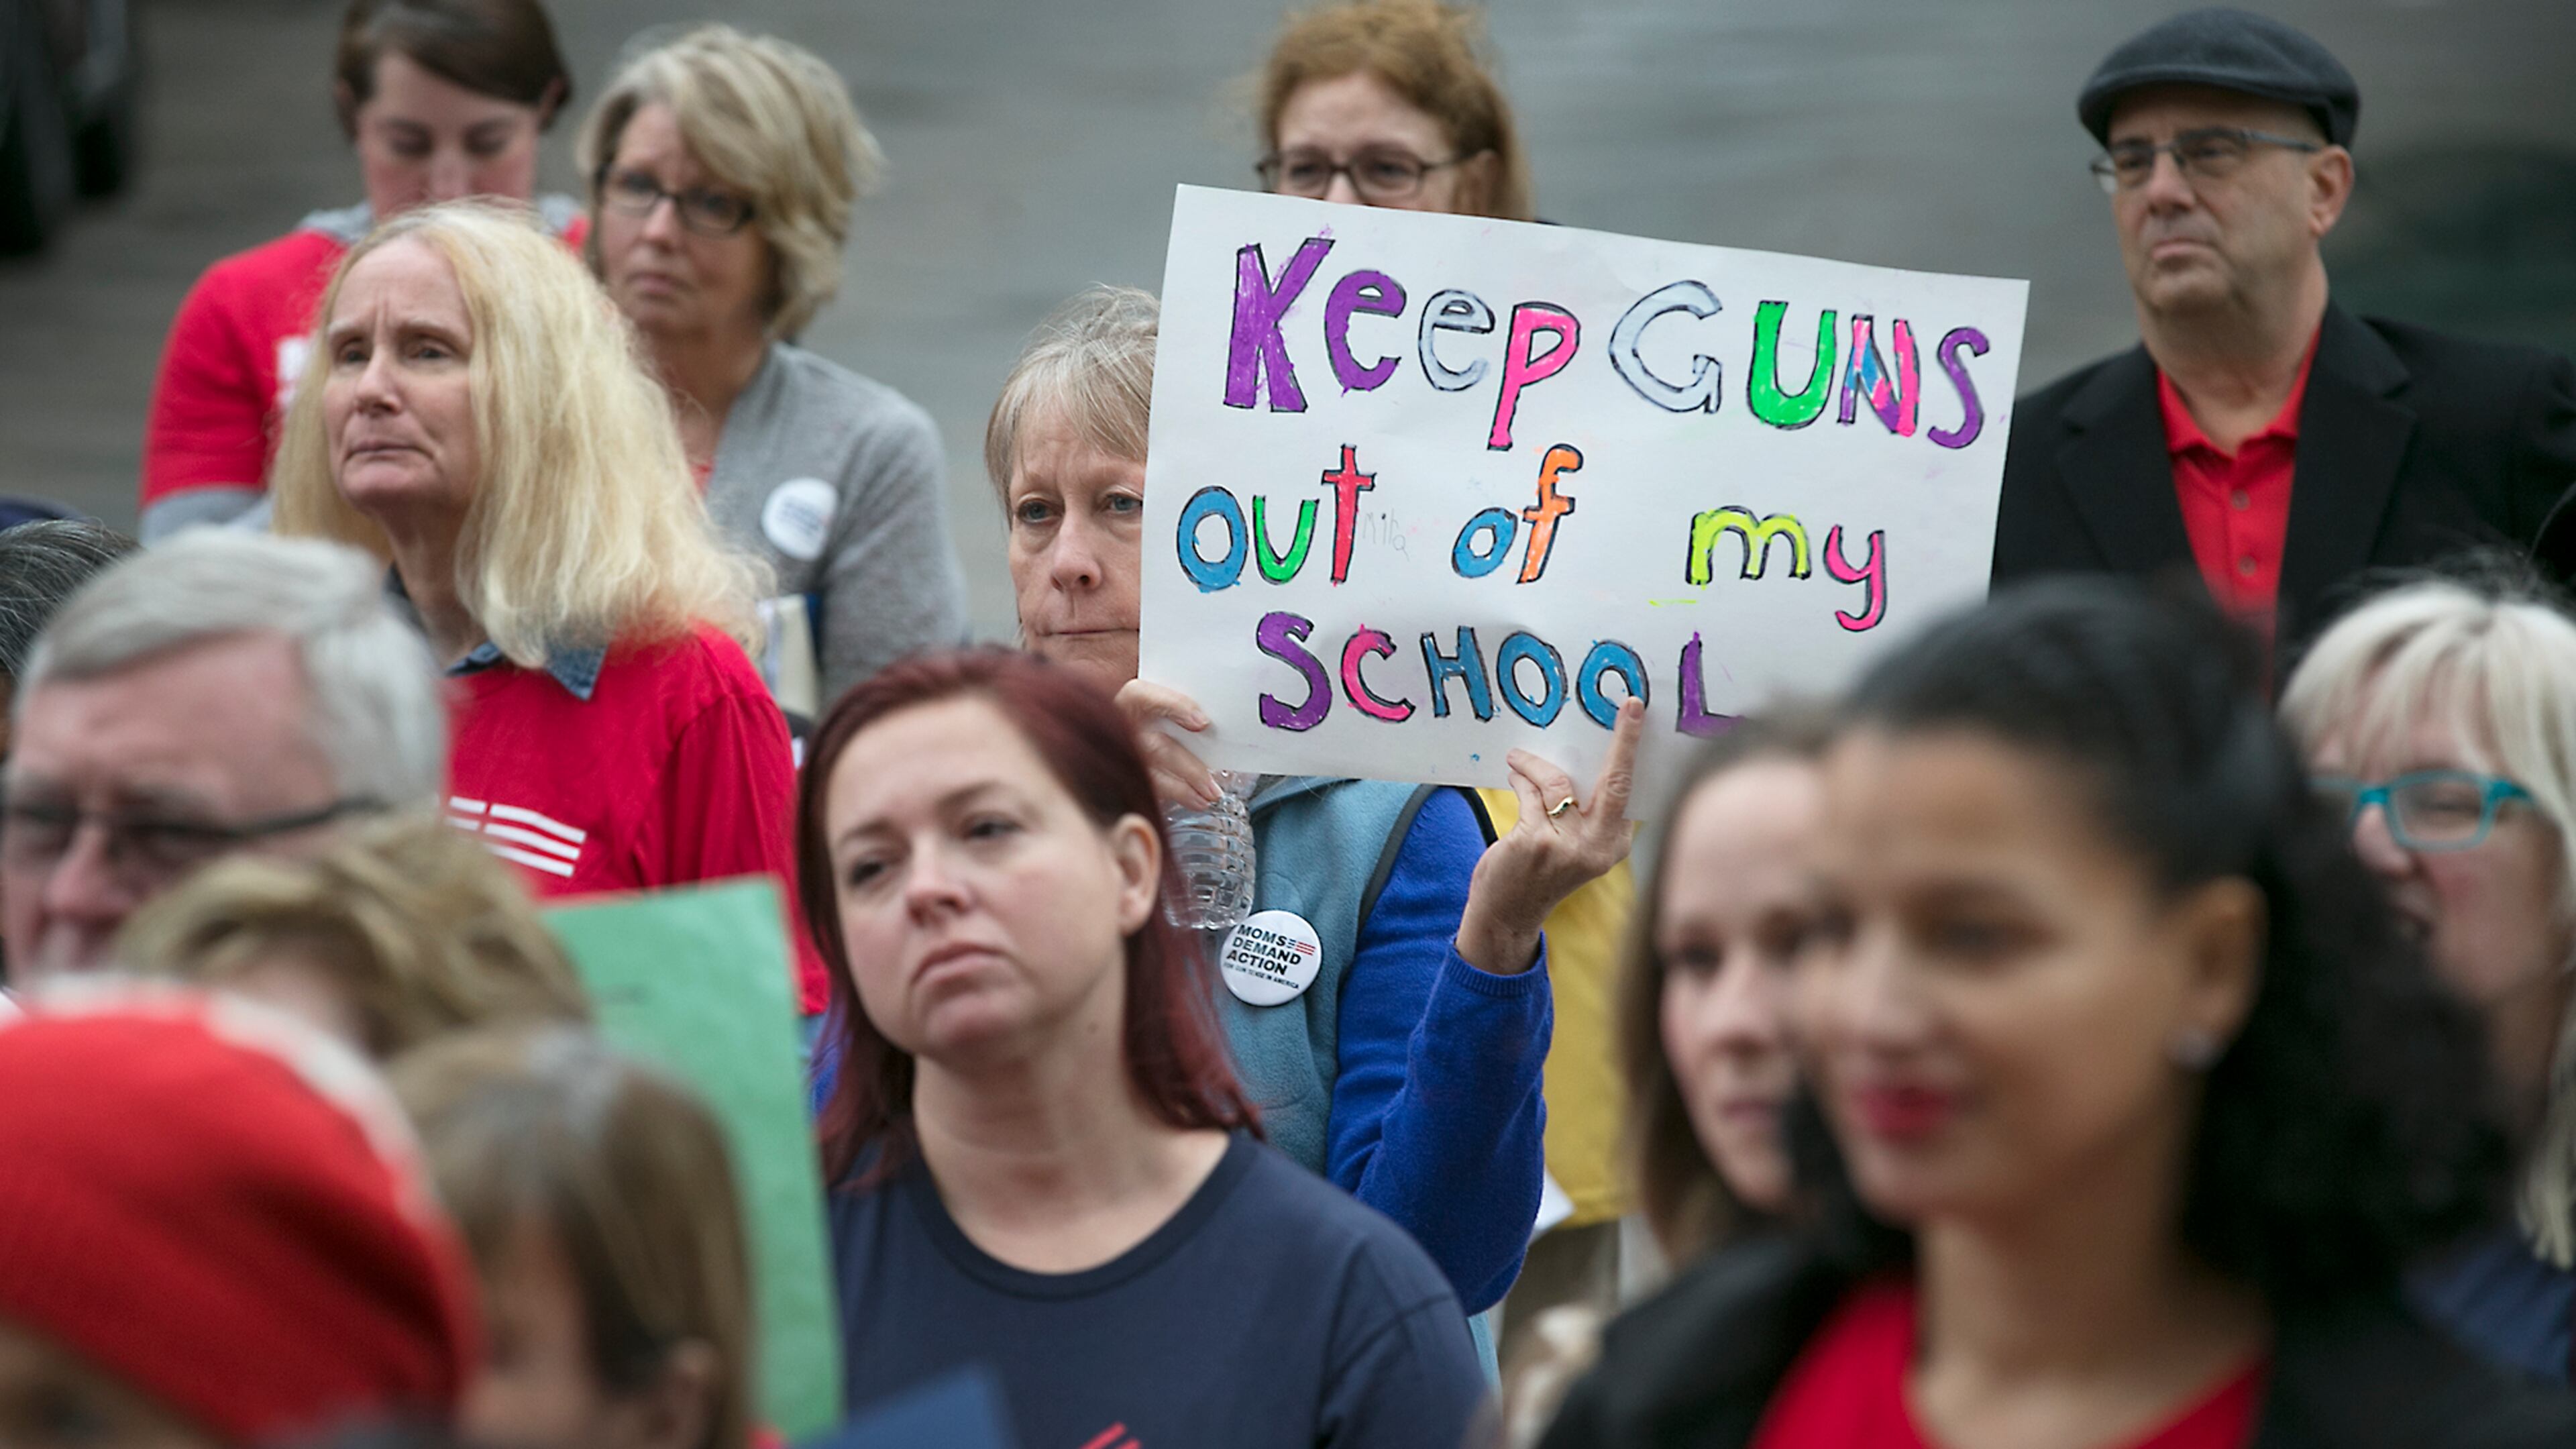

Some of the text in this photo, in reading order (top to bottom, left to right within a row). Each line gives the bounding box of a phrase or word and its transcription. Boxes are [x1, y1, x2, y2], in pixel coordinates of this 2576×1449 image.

[1609, 279, 1991, 449] GUNS
[1450, 443, 1584, 584] of
[1684, 505, 1886, 633] my
[1255, 610, 1748, 737] SCHOOL
[1226, 950, 1287, 975] ACTION
[1232, 936, 1301, 965] DEMAND
[1237, 924, 1287, 947] MOMS
